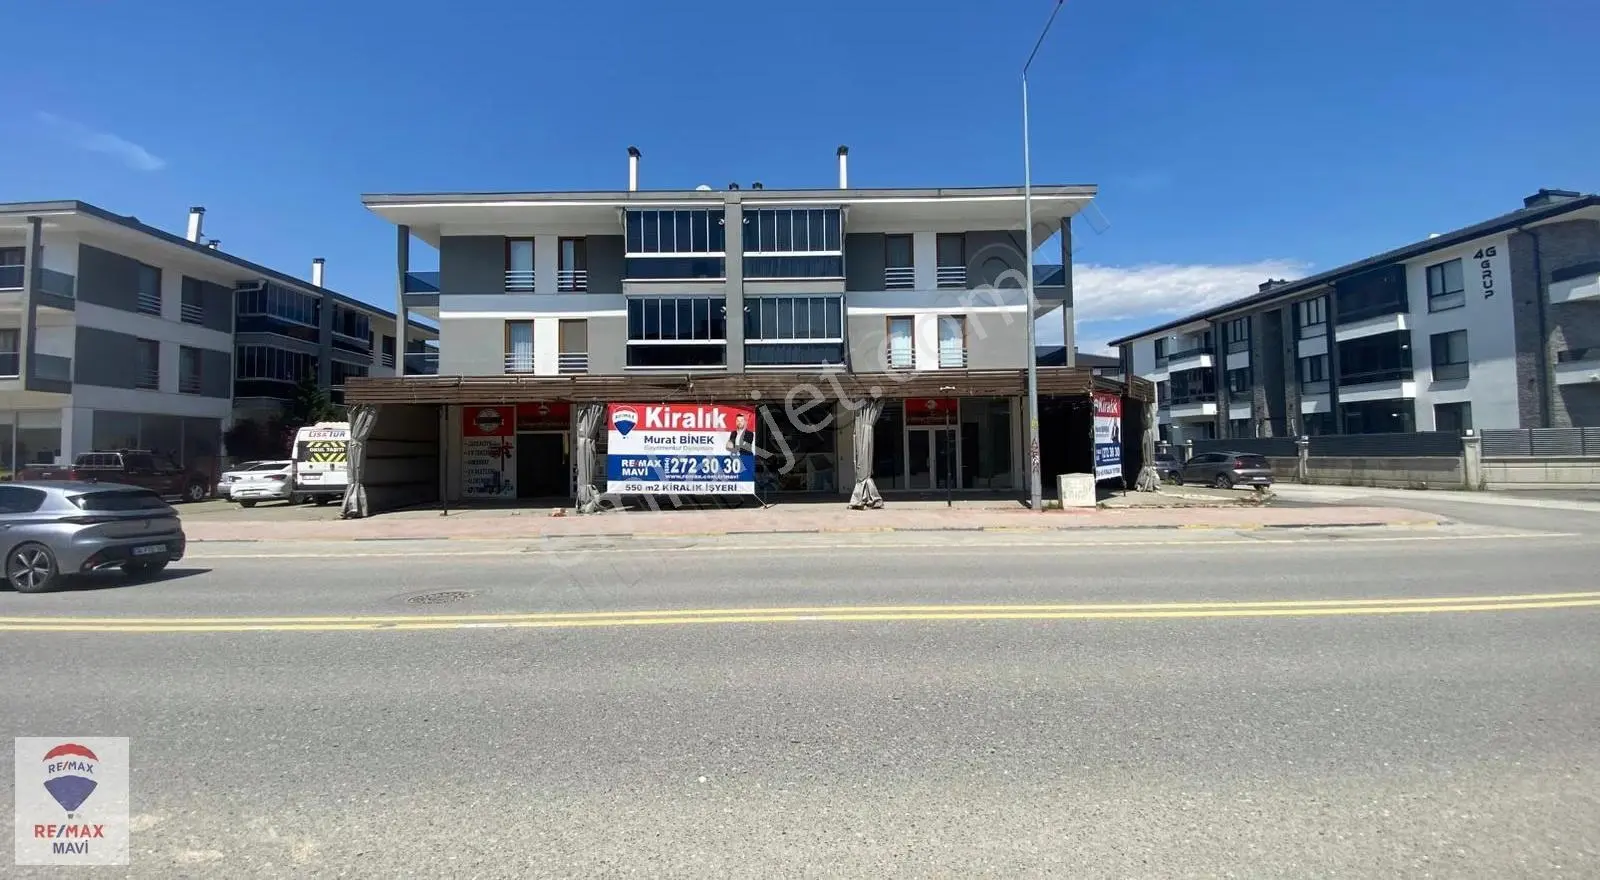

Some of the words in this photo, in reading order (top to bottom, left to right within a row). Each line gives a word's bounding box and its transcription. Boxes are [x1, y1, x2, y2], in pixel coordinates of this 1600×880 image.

[1473, 246, 1497, 259] 4G
[1481, 259, 1494, 300] GRUP
[645, 406, 727, 429] Kiralık
[644, 435, 676, 444] Murat
[679, 433, 715, 444] BİNEK
[621, 459, 662, 467] RE/MAX
[670, 457, 697, 474] 272
[701, 458, 719, 473] 30
[723, 458, 741, 473] 30
[622, 467, 648, 476] MAVİ
[662, 483, 703, 491] KİRALIK
[705, 483, 737, 493] İŞYERİ
